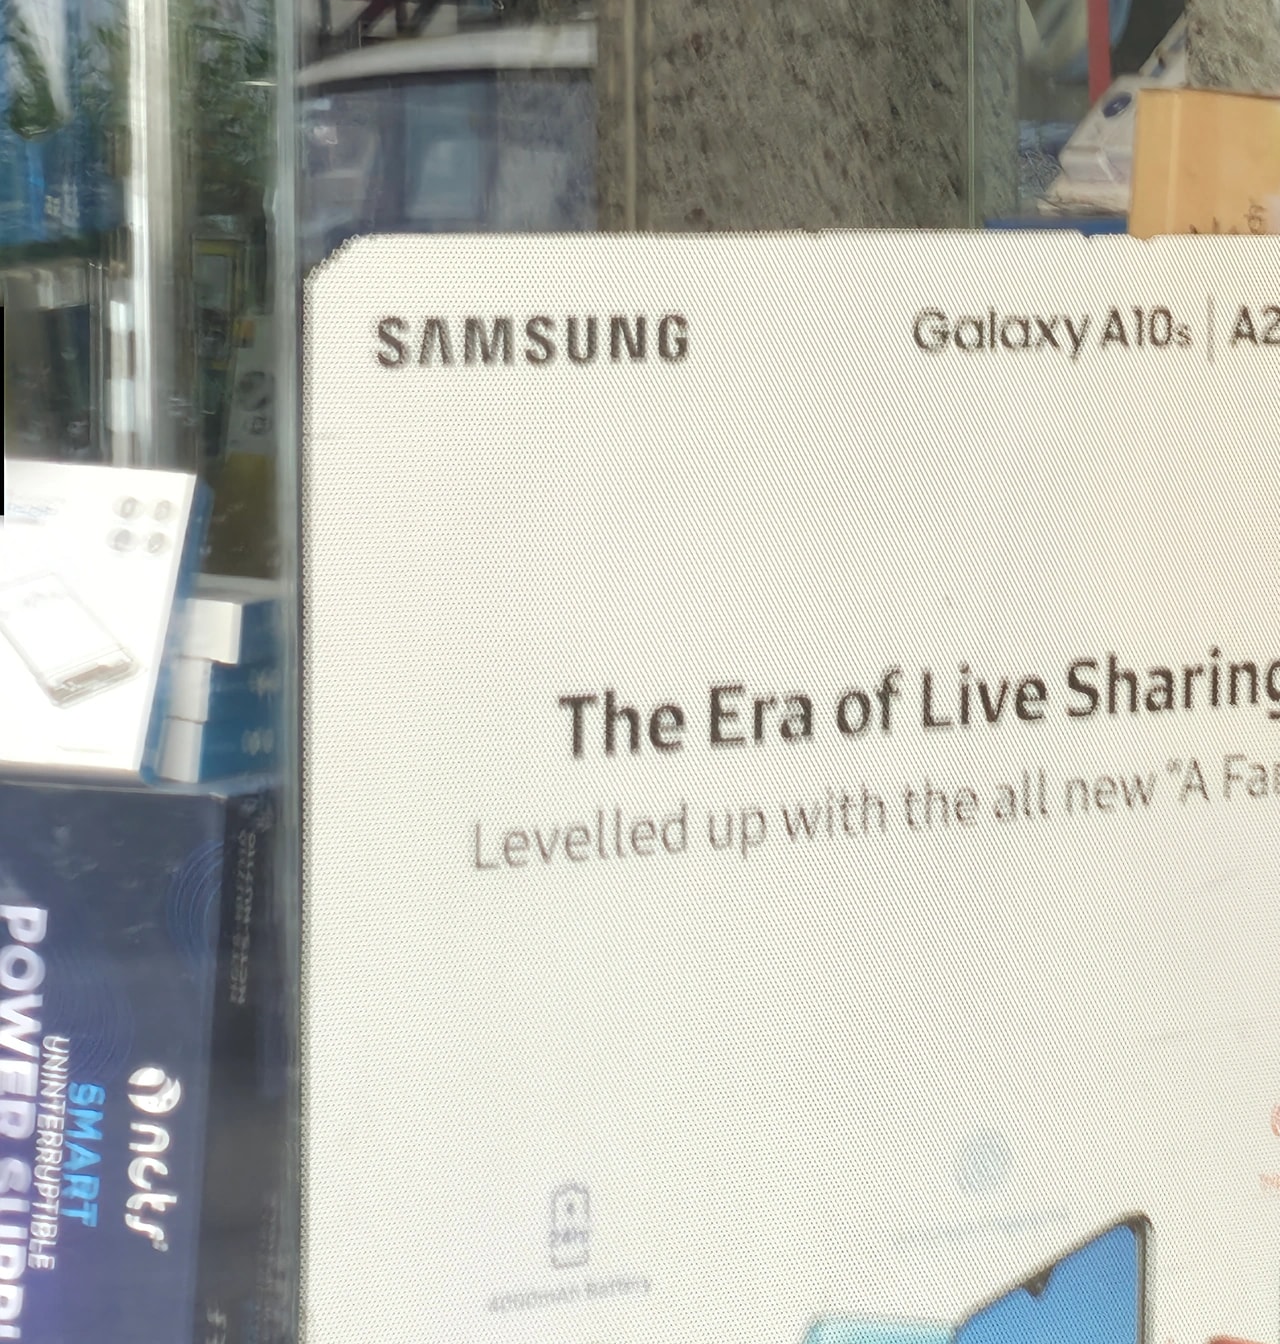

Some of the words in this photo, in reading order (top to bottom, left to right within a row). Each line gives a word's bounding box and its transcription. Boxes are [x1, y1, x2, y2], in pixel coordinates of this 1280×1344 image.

[376, 314, 690, 368] SAMSUNG
[912, 304, 1091, 364] Galaxy
[1101, 304, 1192, 348] A10s
[558, 688, 686, 758] The
[710, 681, 814, 746] Era
[836, 665, 902, 736] of
[922, 662, 1048, 730] Live
[473, 799, 689, 873] Levelled
[708, 804, 767, 860] up
[783, 782, 887, 844] with
[904, 776, 979, 832] the
[995, 766, 1049, 823] all
[1065, 770, 1158, 814] new
[0, 905, 48, 1139] POWER
[29, 1036, 70, 1270] UNINTERRUPTIBLE
[60, 1082, 106, 1227] SMART
